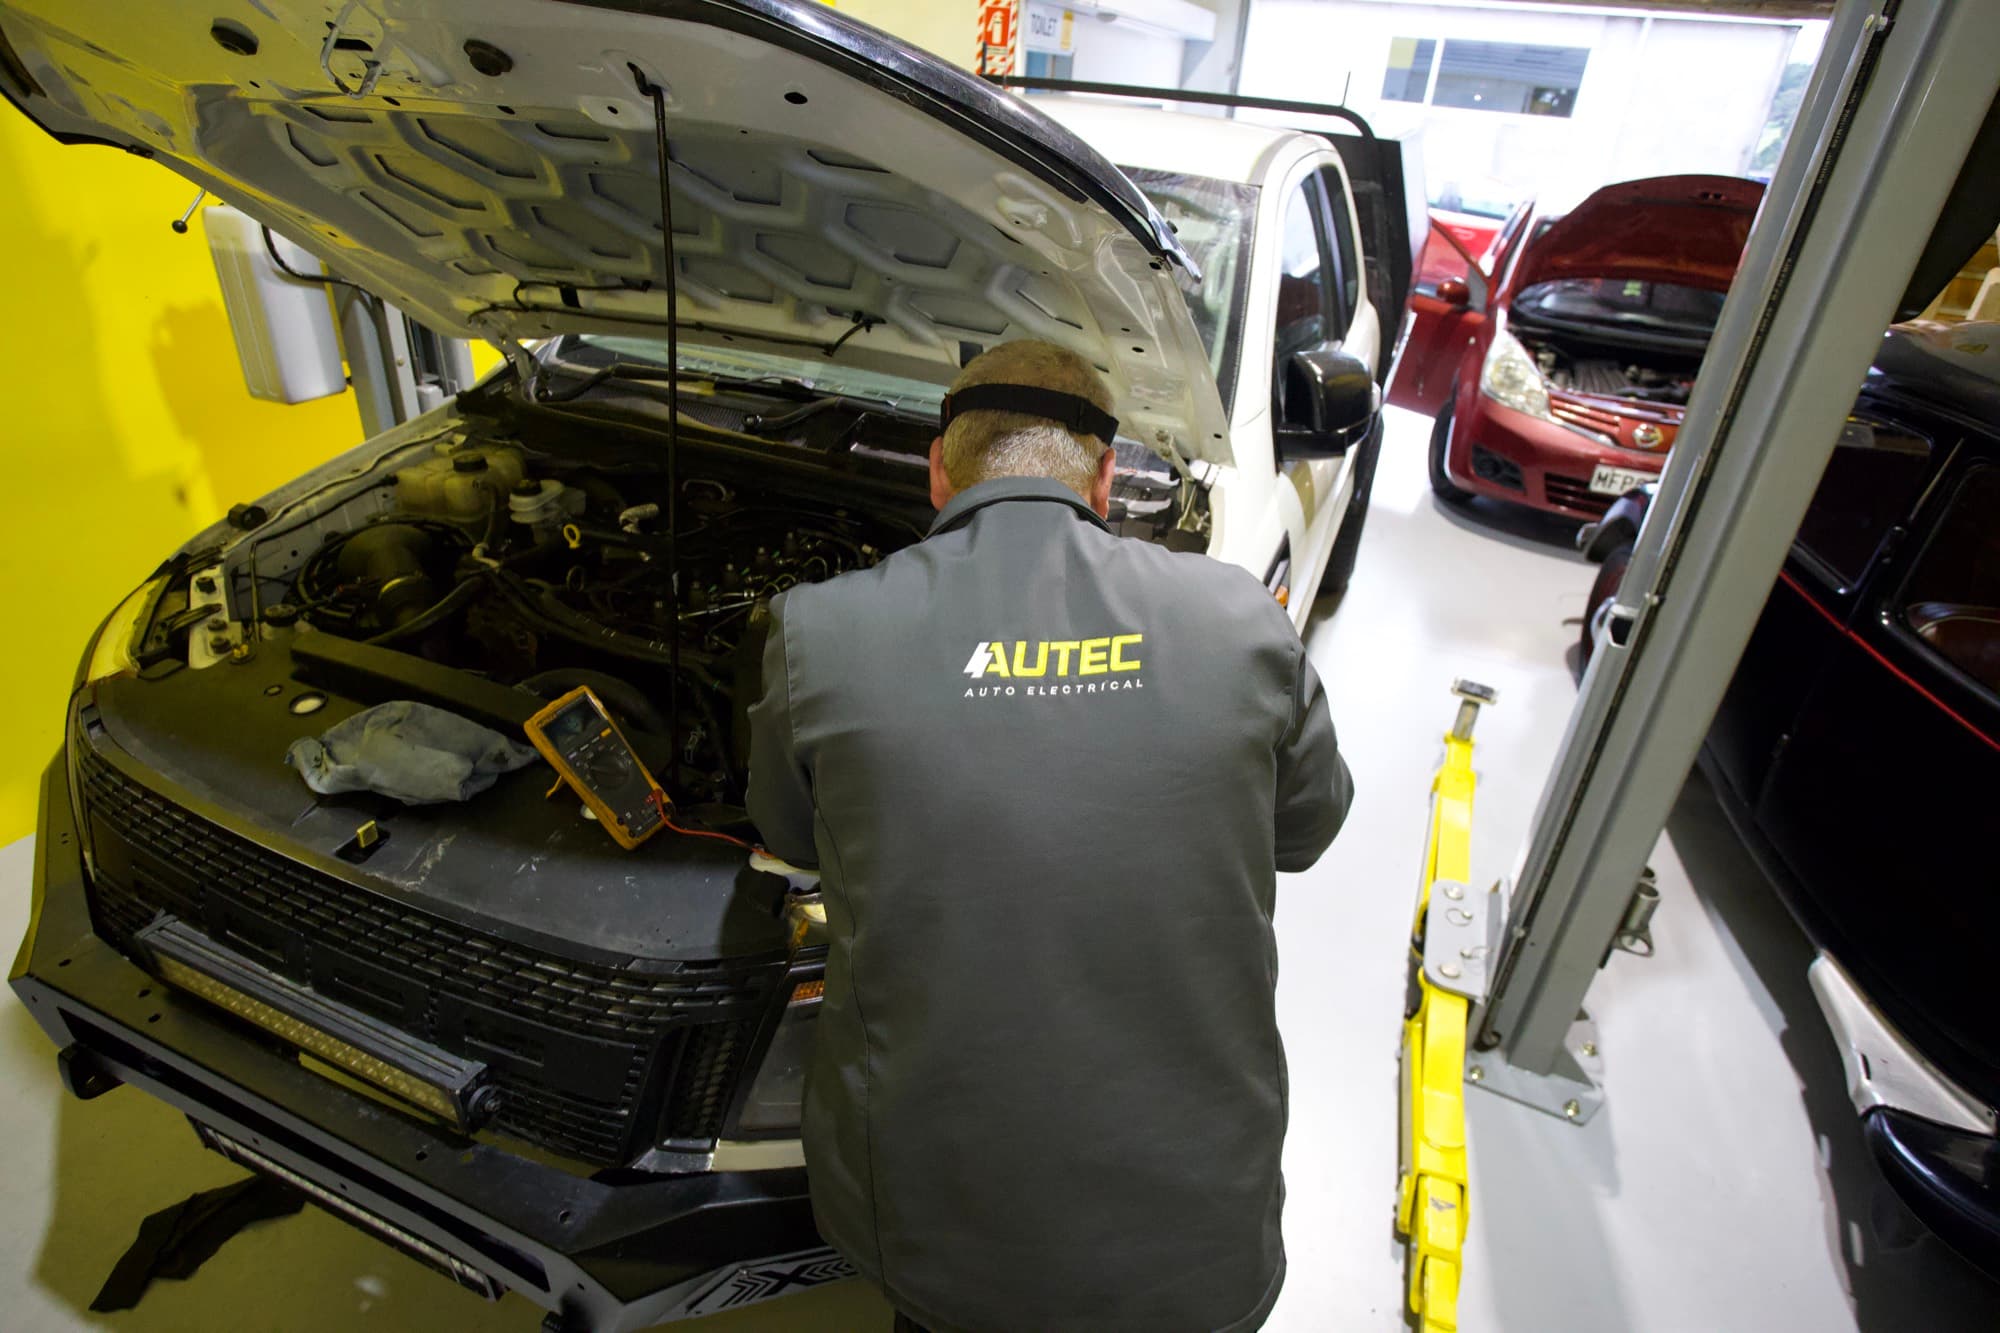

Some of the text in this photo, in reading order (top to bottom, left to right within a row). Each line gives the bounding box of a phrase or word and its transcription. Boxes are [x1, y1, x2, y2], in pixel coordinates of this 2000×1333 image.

[1031, 13, 1057, 37] TOILET
[963, 634, 1143, 679] AUTEC
[964, 678, 1143, 698] AUTO ELECTRICAL
